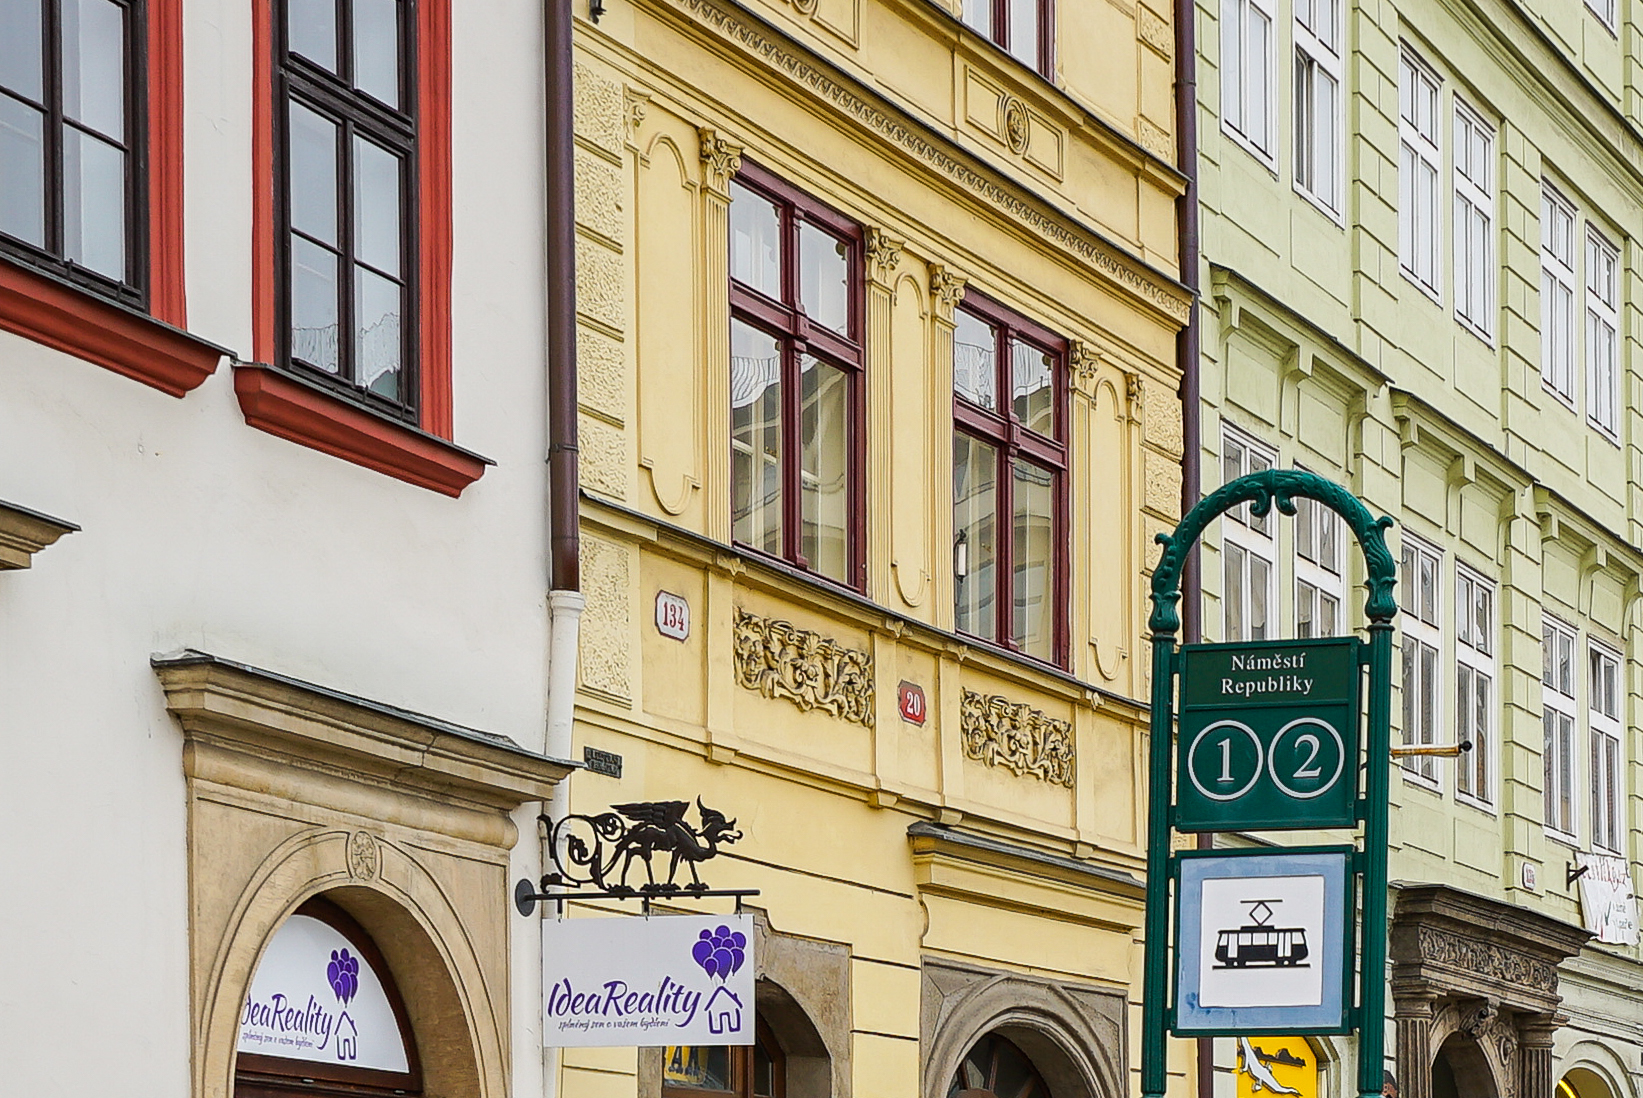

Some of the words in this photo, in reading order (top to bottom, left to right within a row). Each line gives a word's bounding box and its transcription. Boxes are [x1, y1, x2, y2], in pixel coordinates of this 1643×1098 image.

[662, 602, 685, 632] 134
[1231, 652, 1307, 672] Náměstí
[905, 690, 922, 709] 20
[1221, 676, 1314, 697] Republiky
[1216, 738, 1235, 782] 1
[1292, 734, 1322, 778] 2
[547, 975, 703, 1028] IdeaReality
[241, 993, 333, 1050] deaReality
